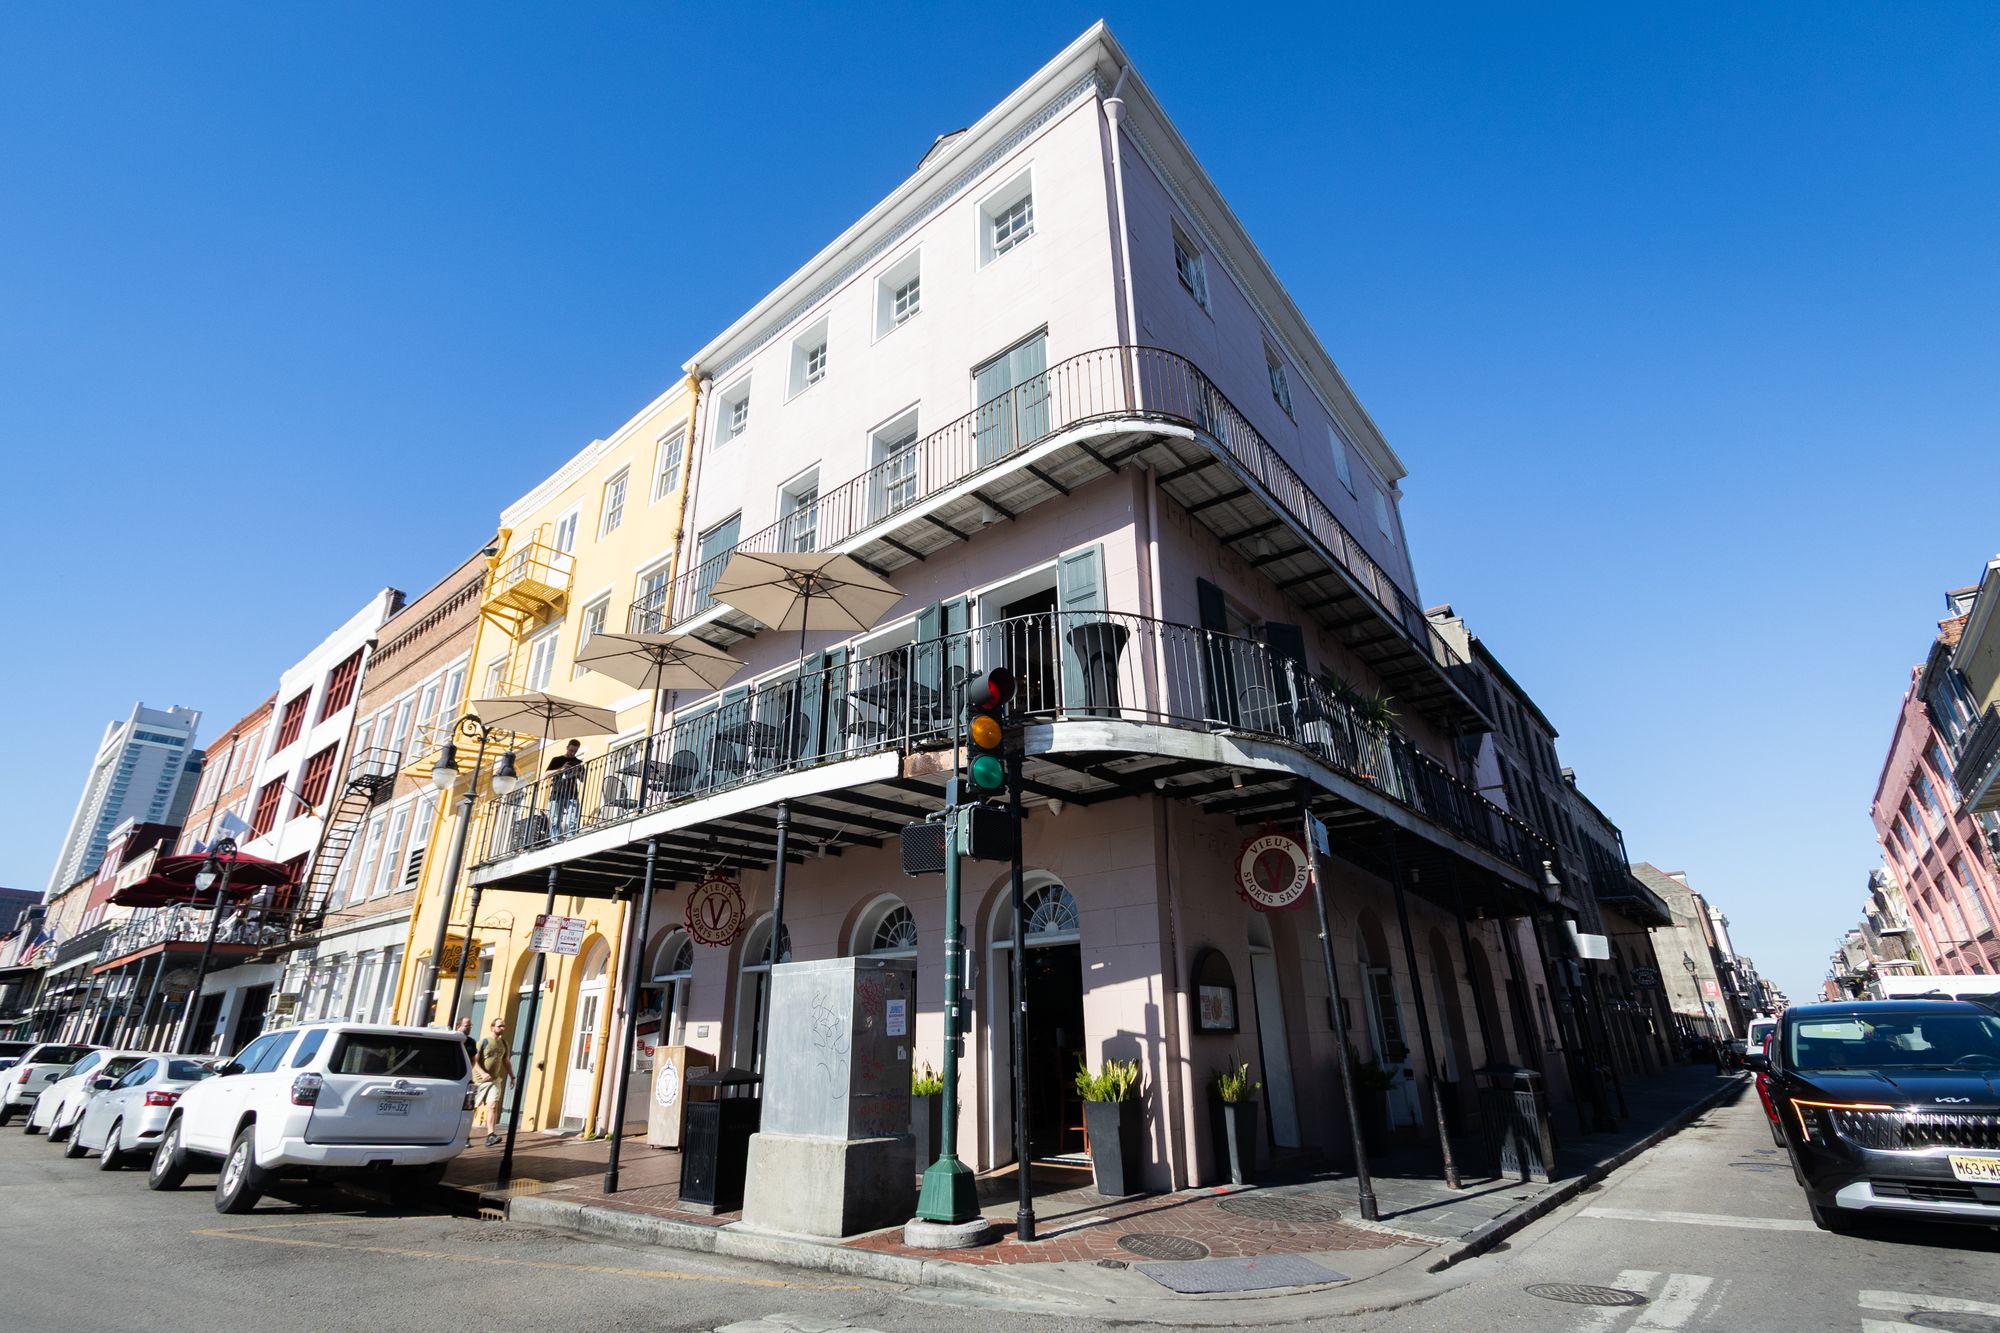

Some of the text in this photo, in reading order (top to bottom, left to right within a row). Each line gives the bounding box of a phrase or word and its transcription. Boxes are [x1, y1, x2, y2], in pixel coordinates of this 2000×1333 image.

[1250, 838, 1292, 854] VIEUX
[702, 884, 734, 898] VIEUX
[1243, 865, 1306, 904] SPORTS SALOON
[693, 907, 739, 939] SPORTS SALOON
[706, 898, 730, 929] V
